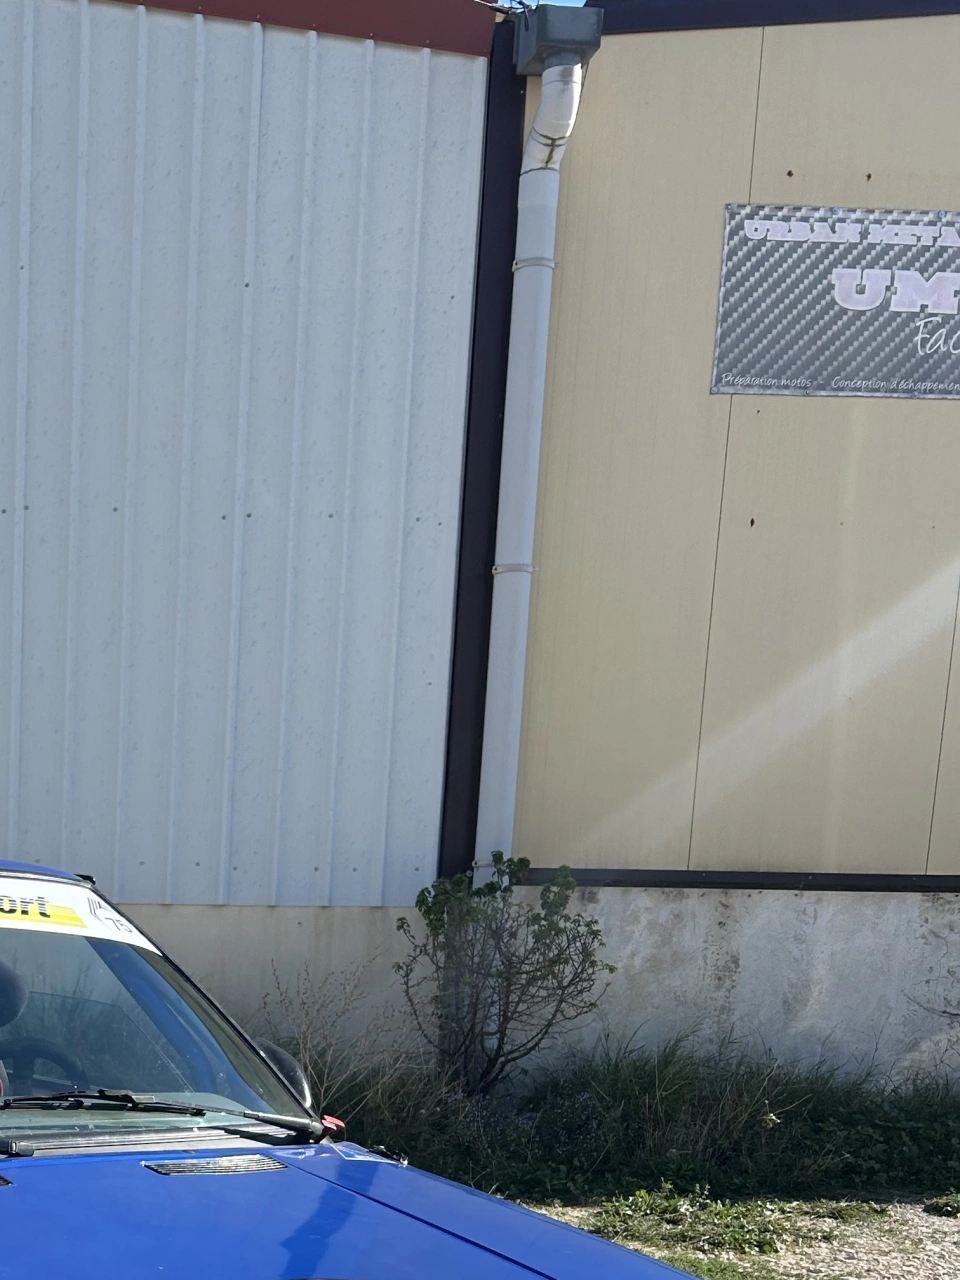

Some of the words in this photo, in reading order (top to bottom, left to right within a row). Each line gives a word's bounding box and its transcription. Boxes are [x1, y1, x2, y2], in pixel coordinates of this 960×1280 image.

[744, 219, 862, 243] URBAN
[721, 372, 778, 388] Préparation
[781, 377, 812, 388] motos
[831, 376, 888, 391] Conception
